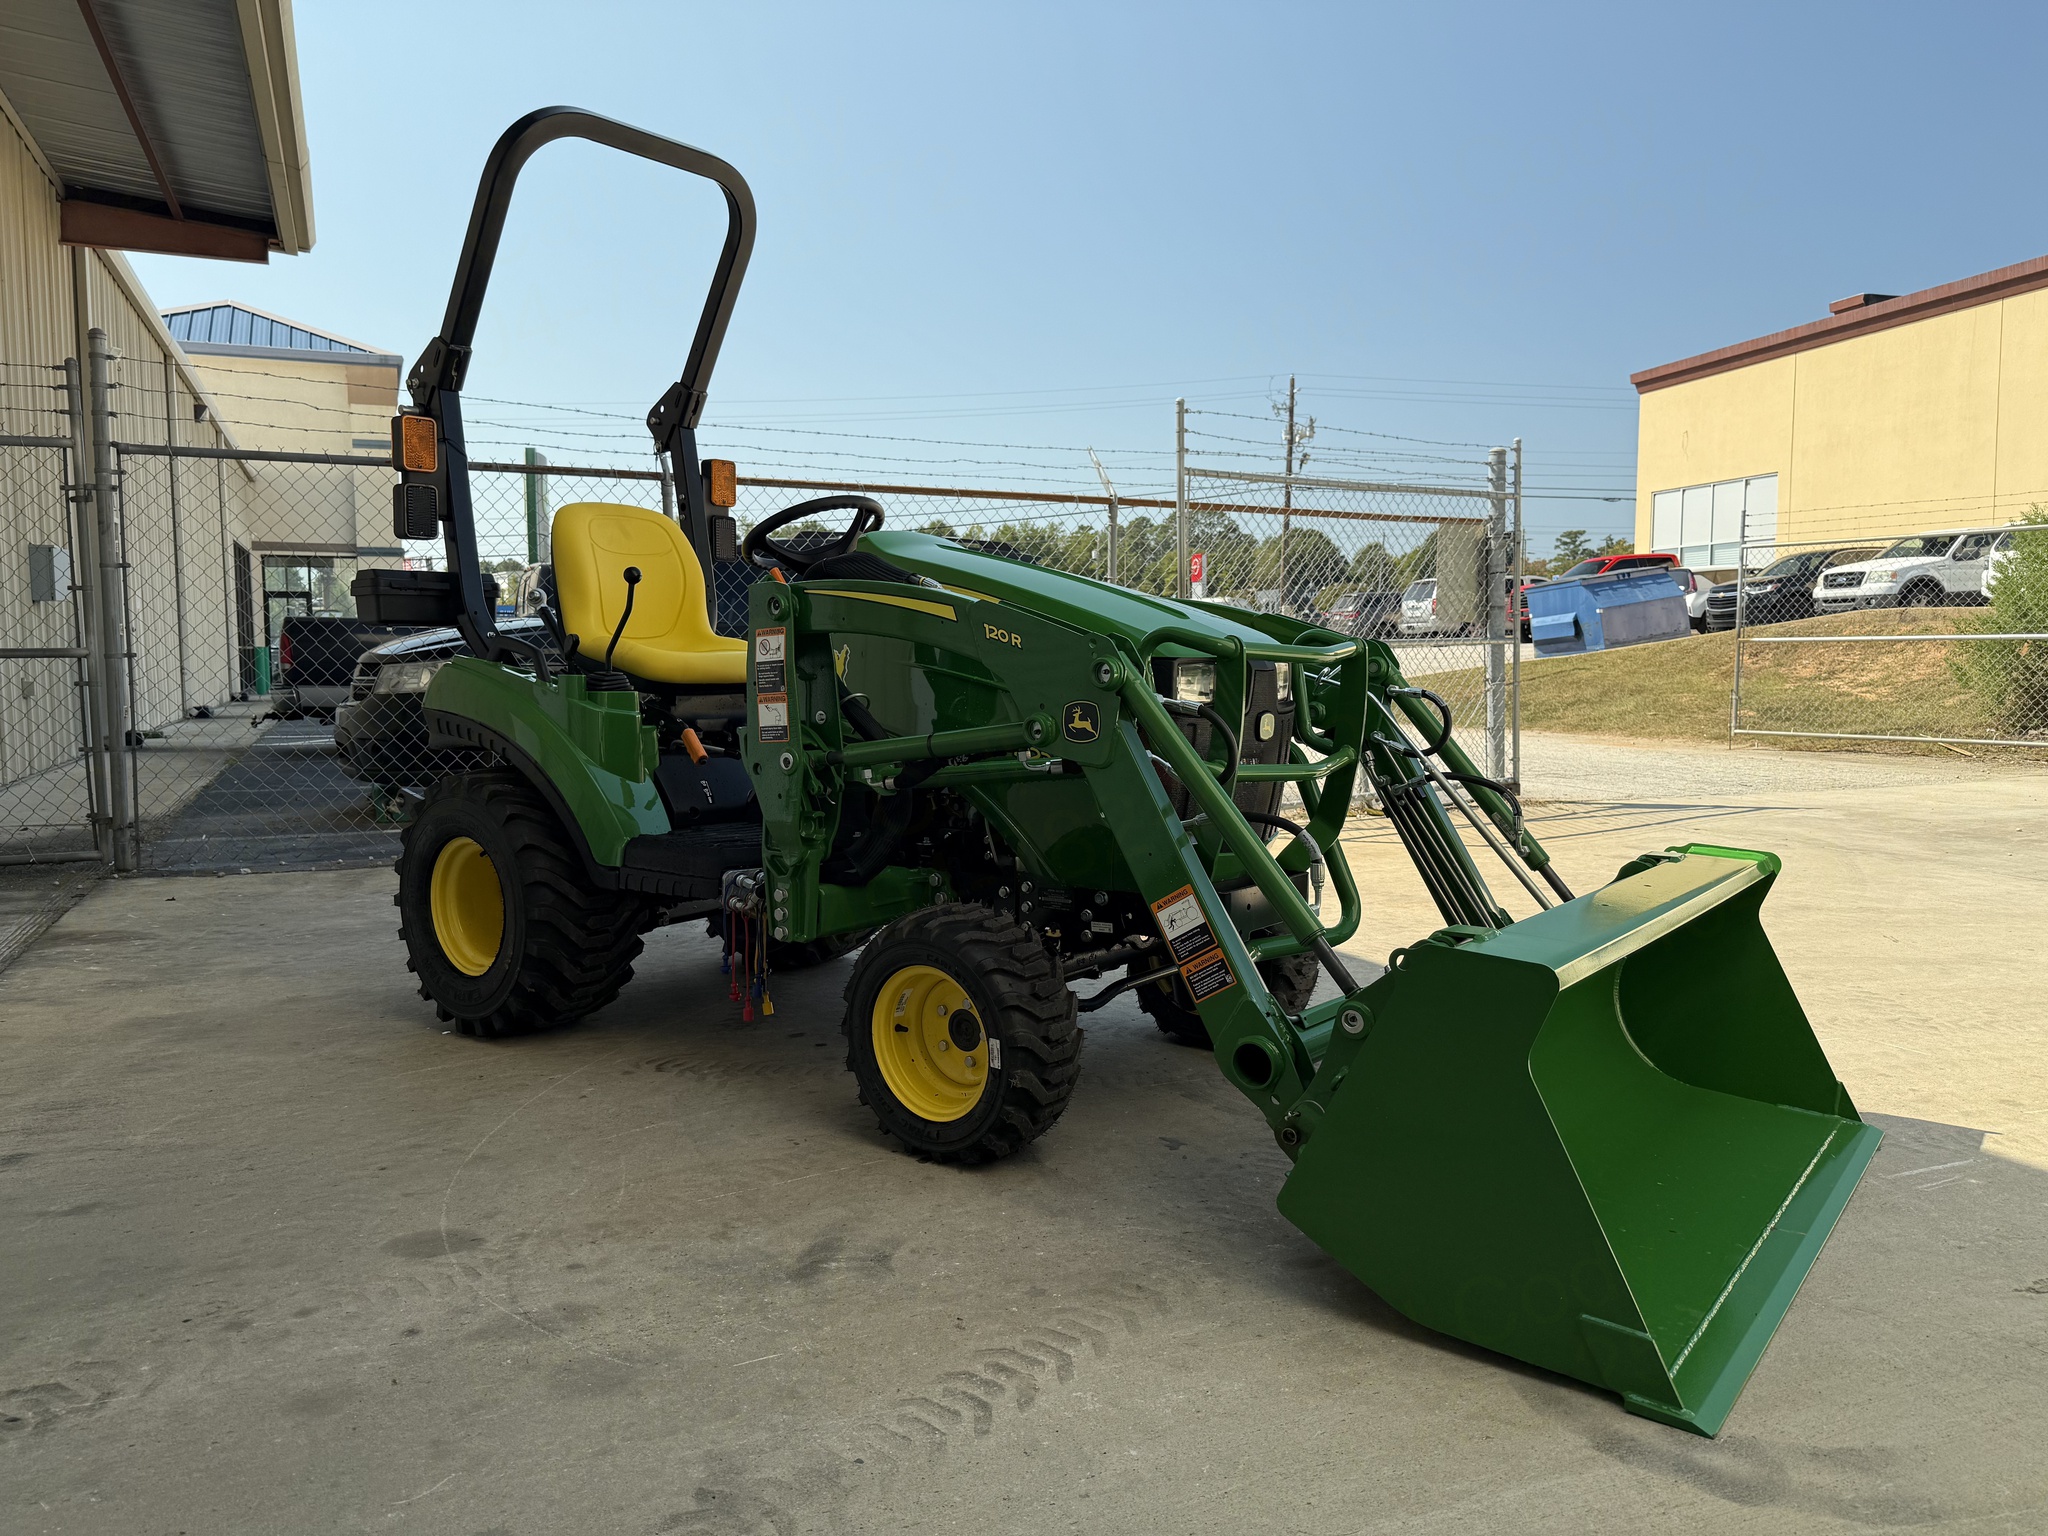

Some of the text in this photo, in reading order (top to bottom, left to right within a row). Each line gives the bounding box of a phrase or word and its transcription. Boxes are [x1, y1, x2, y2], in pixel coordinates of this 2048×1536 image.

[762, 627, 785, 636] WARNING
[983, 623, 1022, 649] 120 R
[762, 695, 786, 703] WARNING
[1162, 888, 1189, 906] WARNING
[1192, 952, 1219, 970] WARNING
